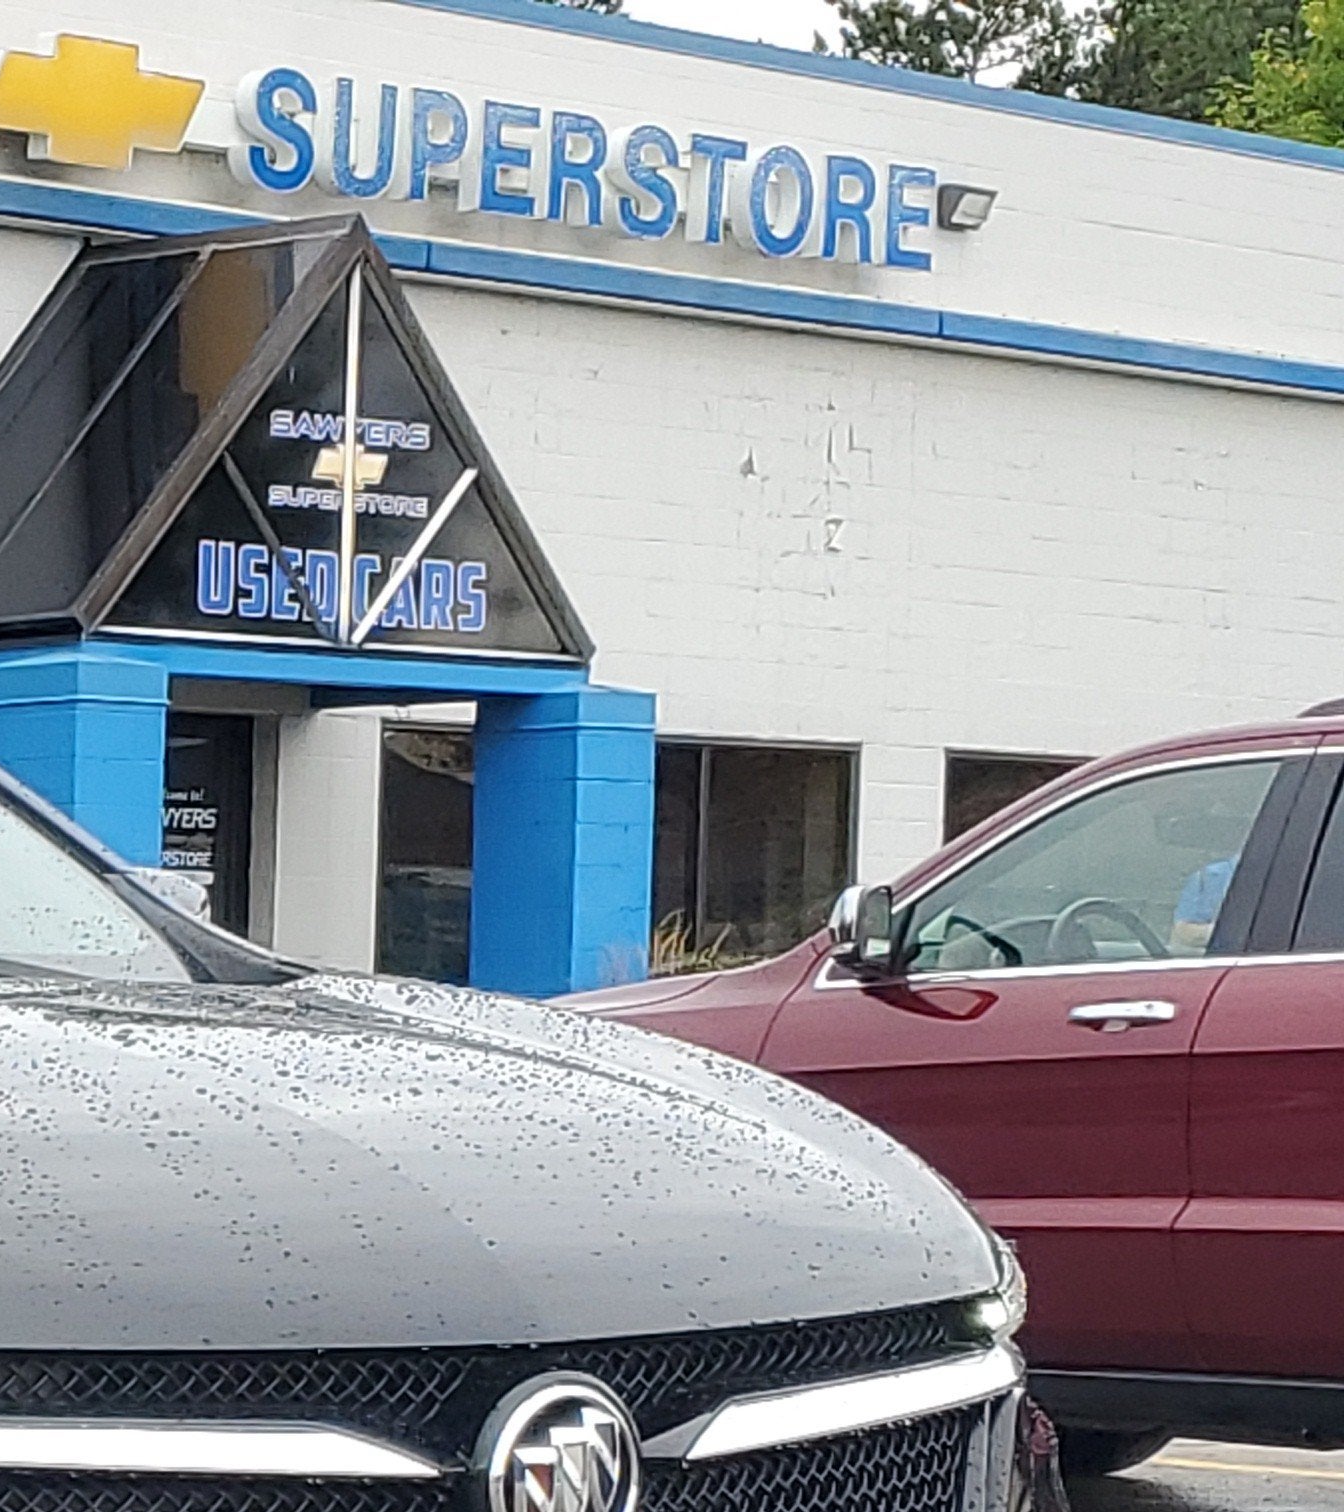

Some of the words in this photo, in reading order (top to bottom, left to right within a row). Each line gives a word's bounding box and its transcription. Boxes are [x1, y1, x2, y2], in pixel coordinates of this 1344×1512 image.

[244, 66, 938, 271] SUPERSTORE
[197, 539, 339, 623] USED
[352, 553, 487, 633] CARS
